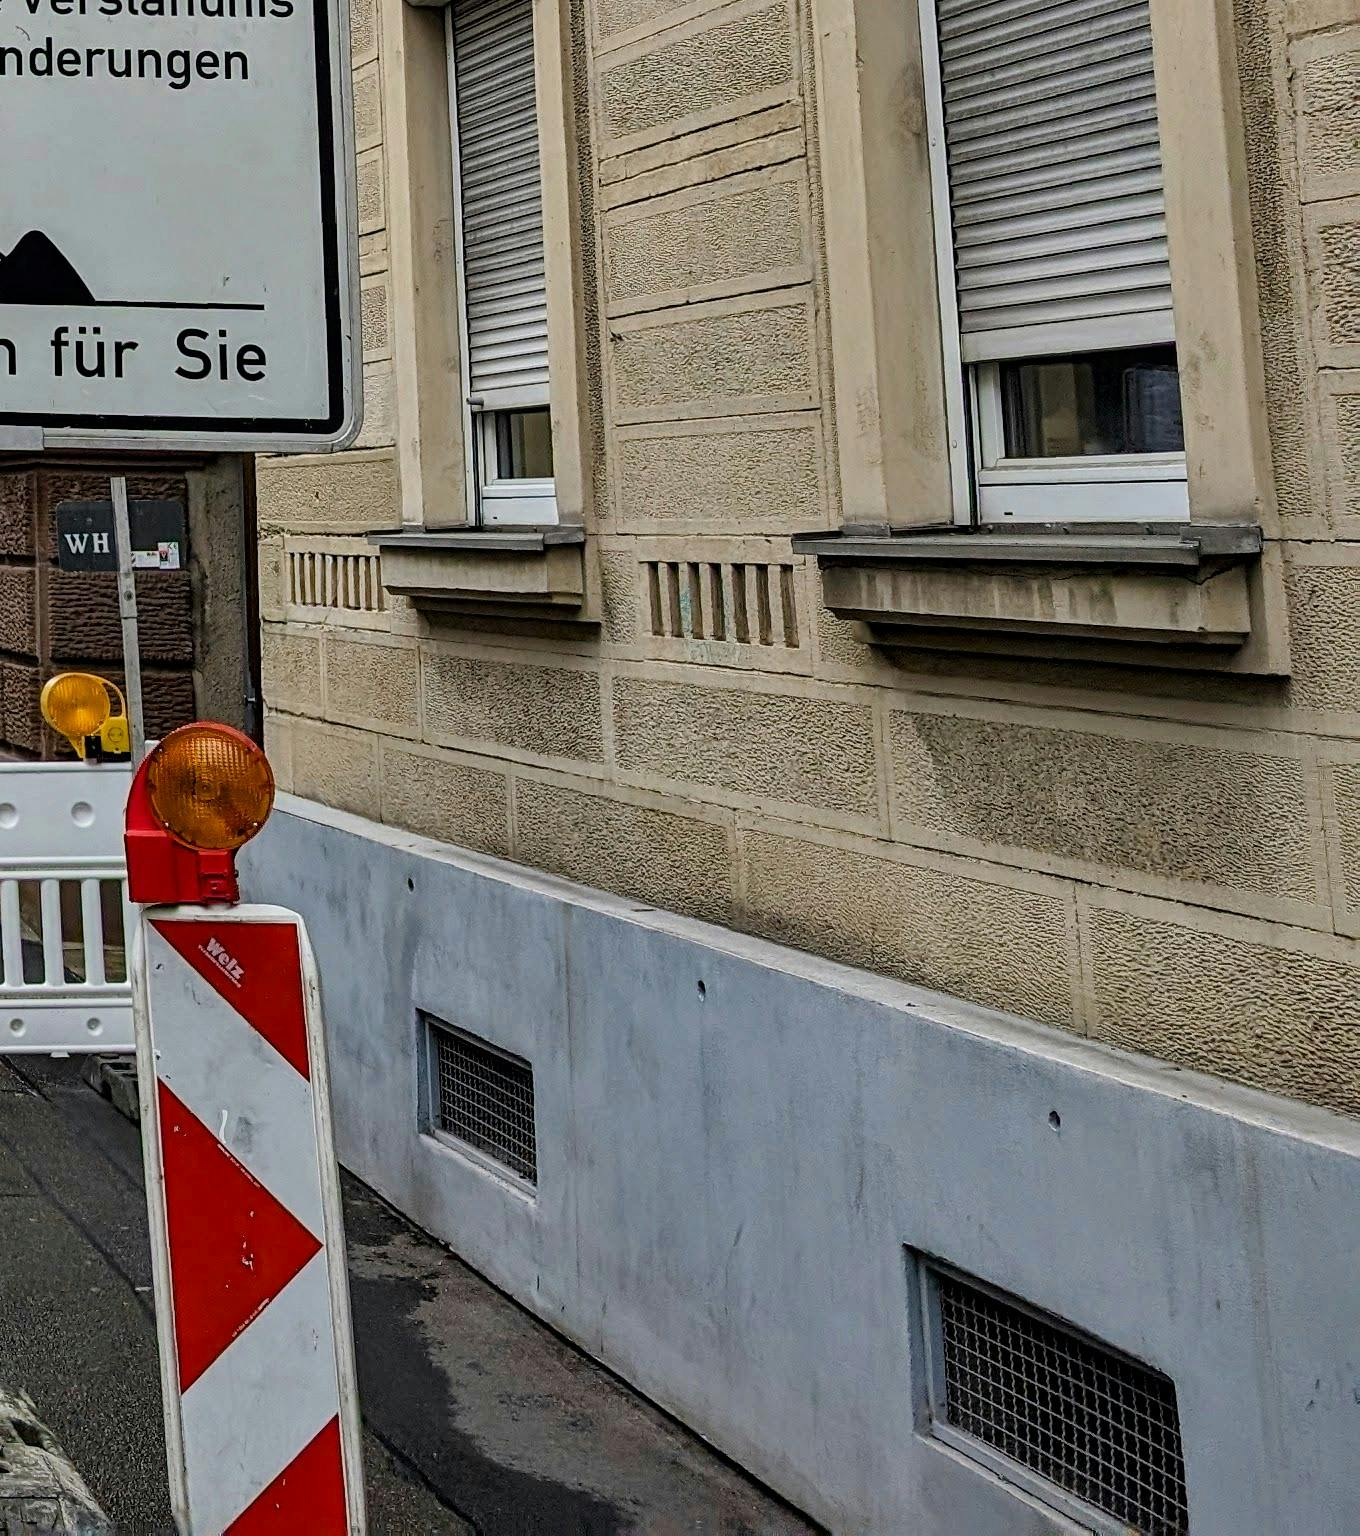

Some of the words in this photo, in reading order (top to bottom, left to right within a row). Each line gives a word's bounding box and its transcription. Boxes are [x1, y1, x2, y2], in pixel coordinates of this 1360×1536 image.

[50, 326, 139, 379] für
[174, 328, 267, 382] Sie
[64, 533, 111, 554] WH
[207, 937, 245, 980] Welz
